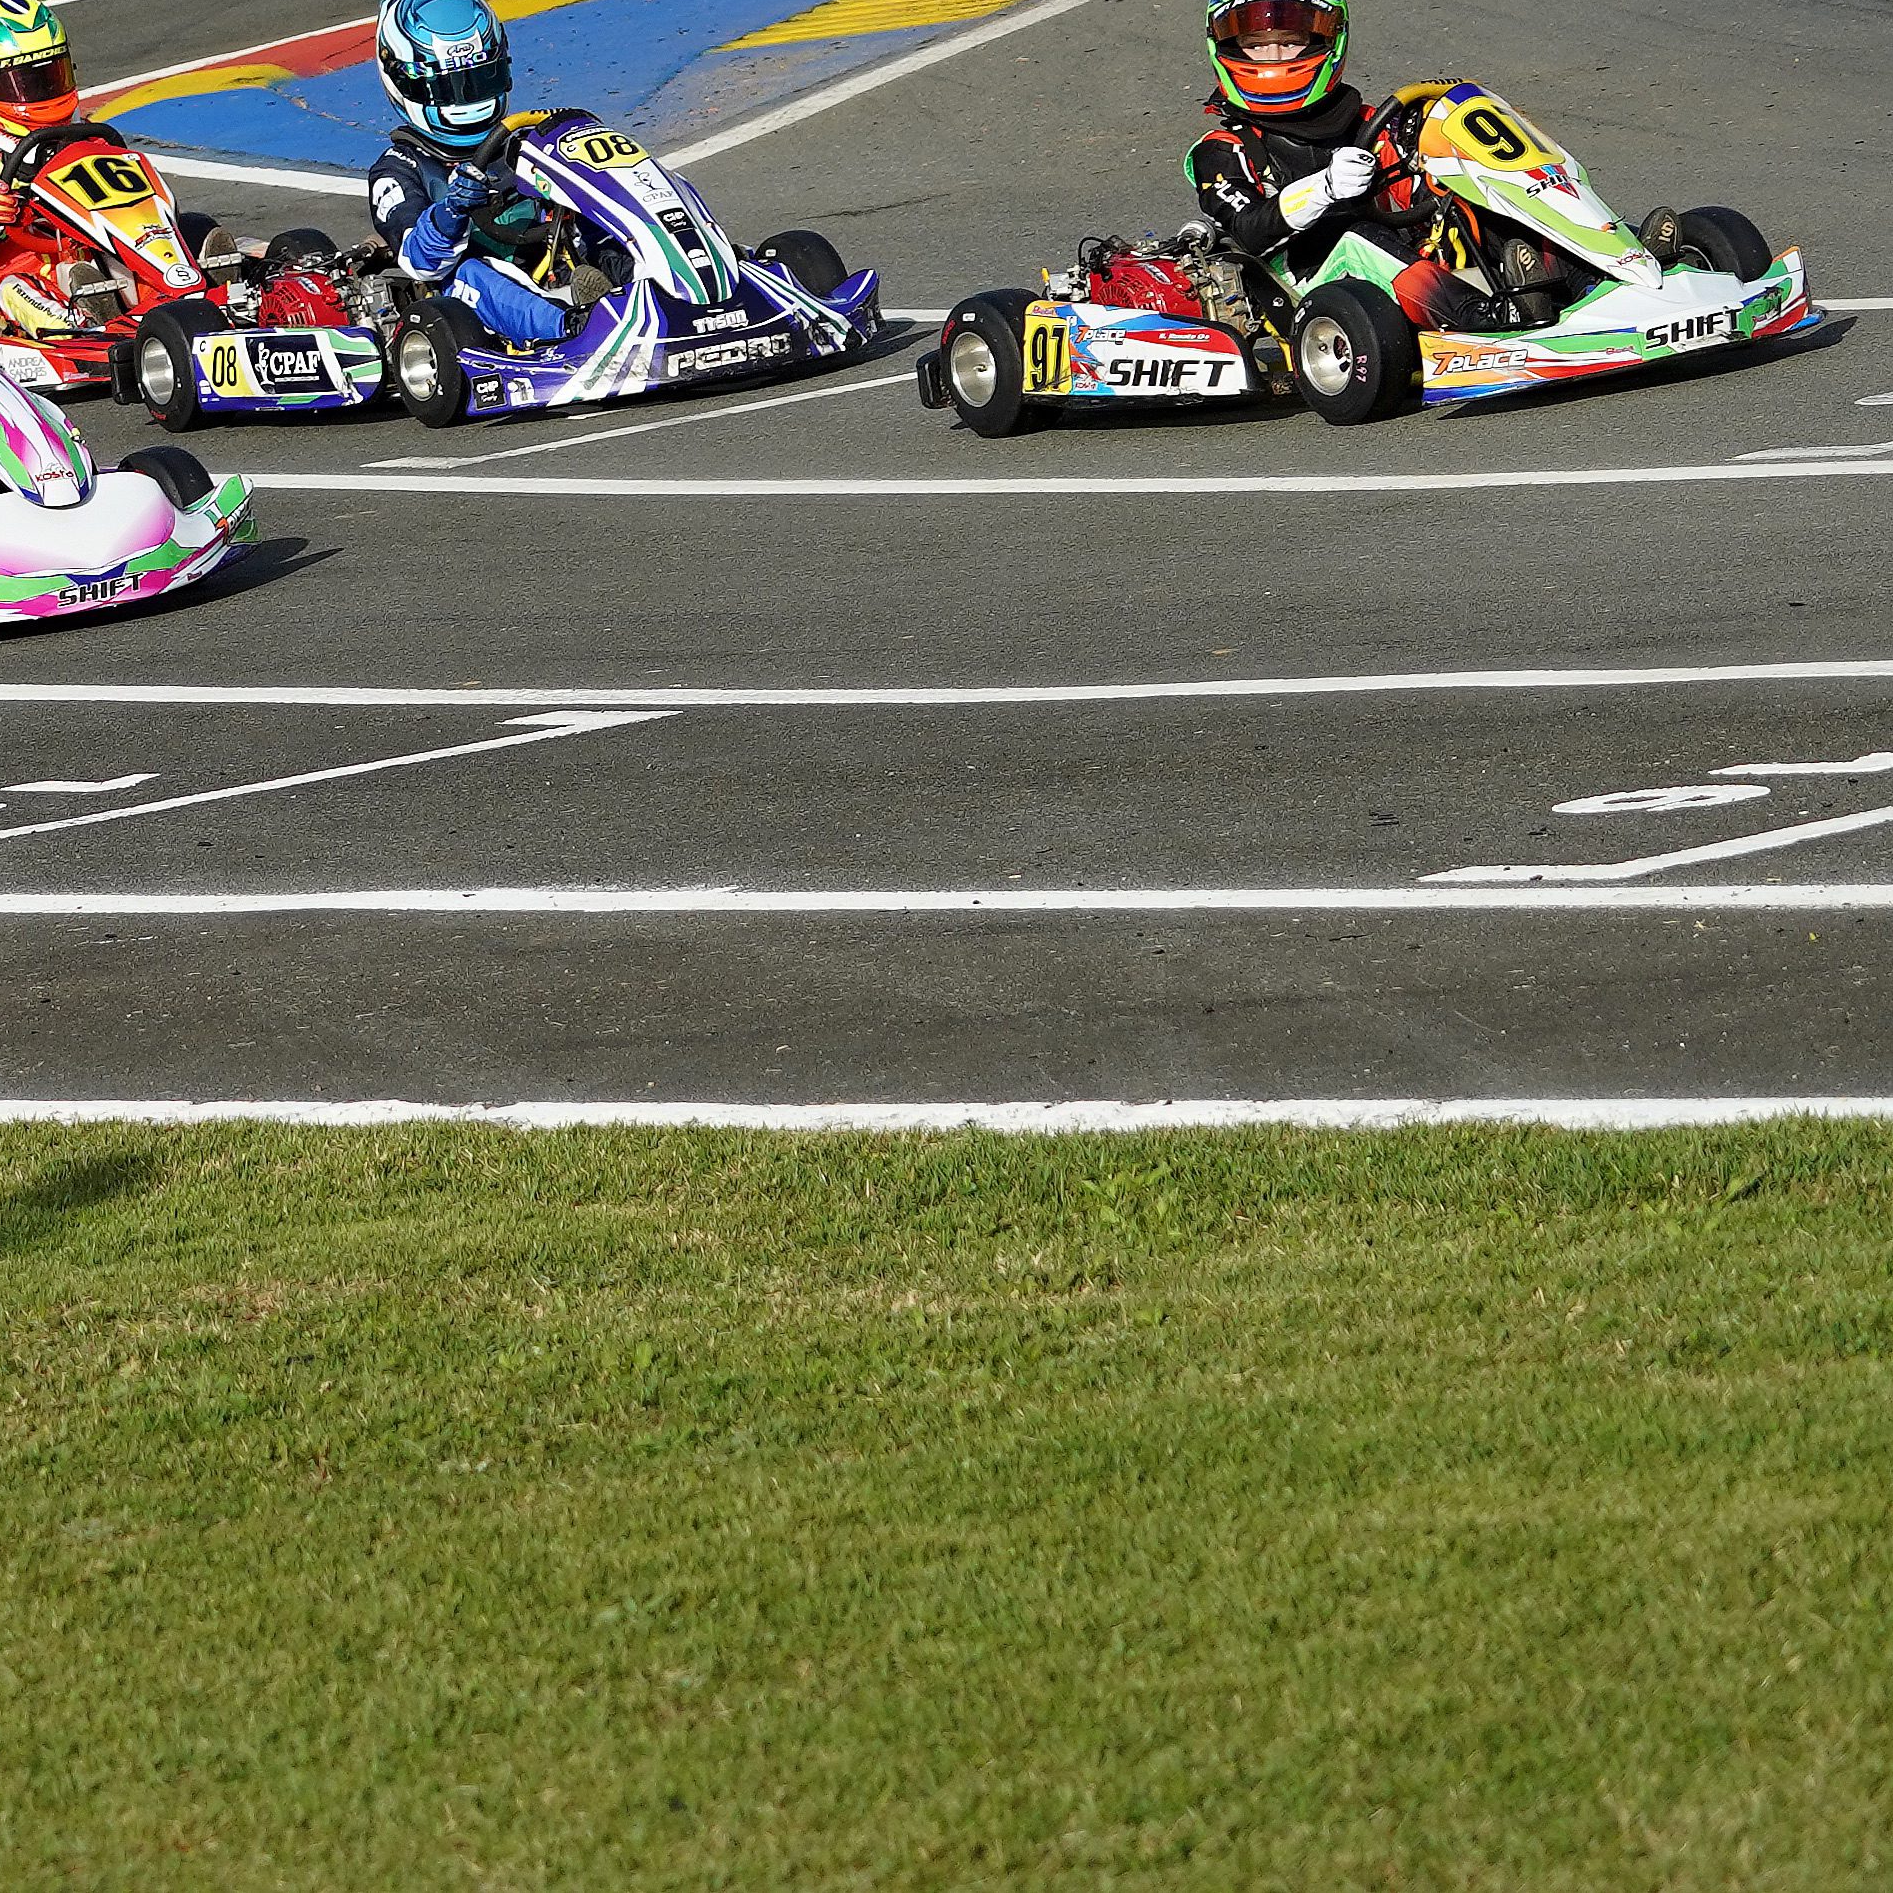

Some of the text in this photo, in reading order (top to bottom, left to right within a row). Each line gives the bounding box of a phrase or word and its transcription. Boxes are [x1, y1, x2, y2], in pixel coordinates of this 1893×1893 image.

[584, 135, 639, 164] 08
[60, 157, 149, 204] 16
[12, 283, 44, 311] Fazenda
[1645, 307, 1743, 350] SHIFT
[199, 340, 238, 388] C 08
[270, 350, 322, 376] CPAF
[667, 333, 791, 378] PEDRO
[1105, 358, 1237, 388] SHIFT
[57, 572, 145, 608] SHIFT
